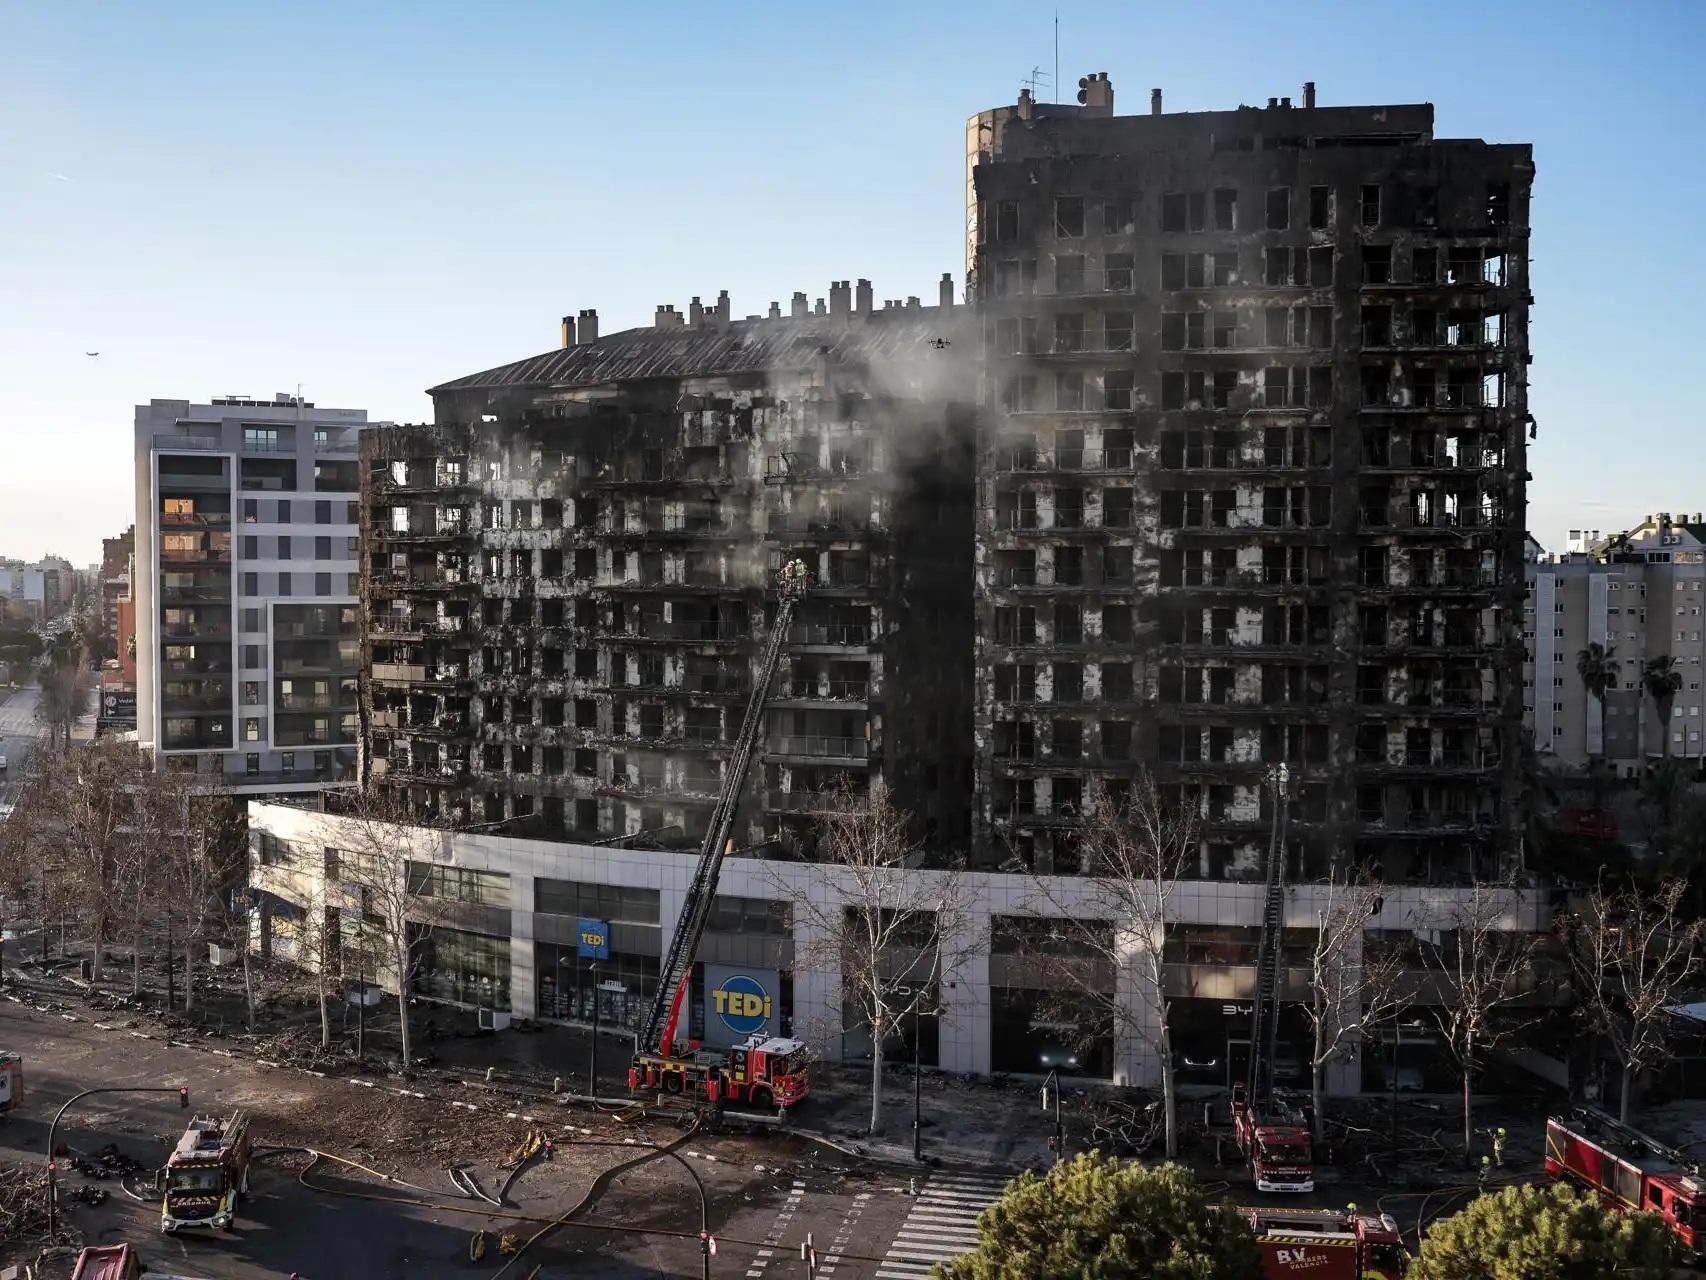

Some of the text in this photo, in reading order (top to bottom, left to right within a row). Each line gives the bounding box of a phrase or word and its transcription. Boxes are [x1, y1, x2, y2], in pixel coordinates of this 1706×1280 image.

[582, 933, 604, 946] TEDi
[712, 989, 773, 1019] TEDi
[1222, 1005, 1266, 1016] BY
